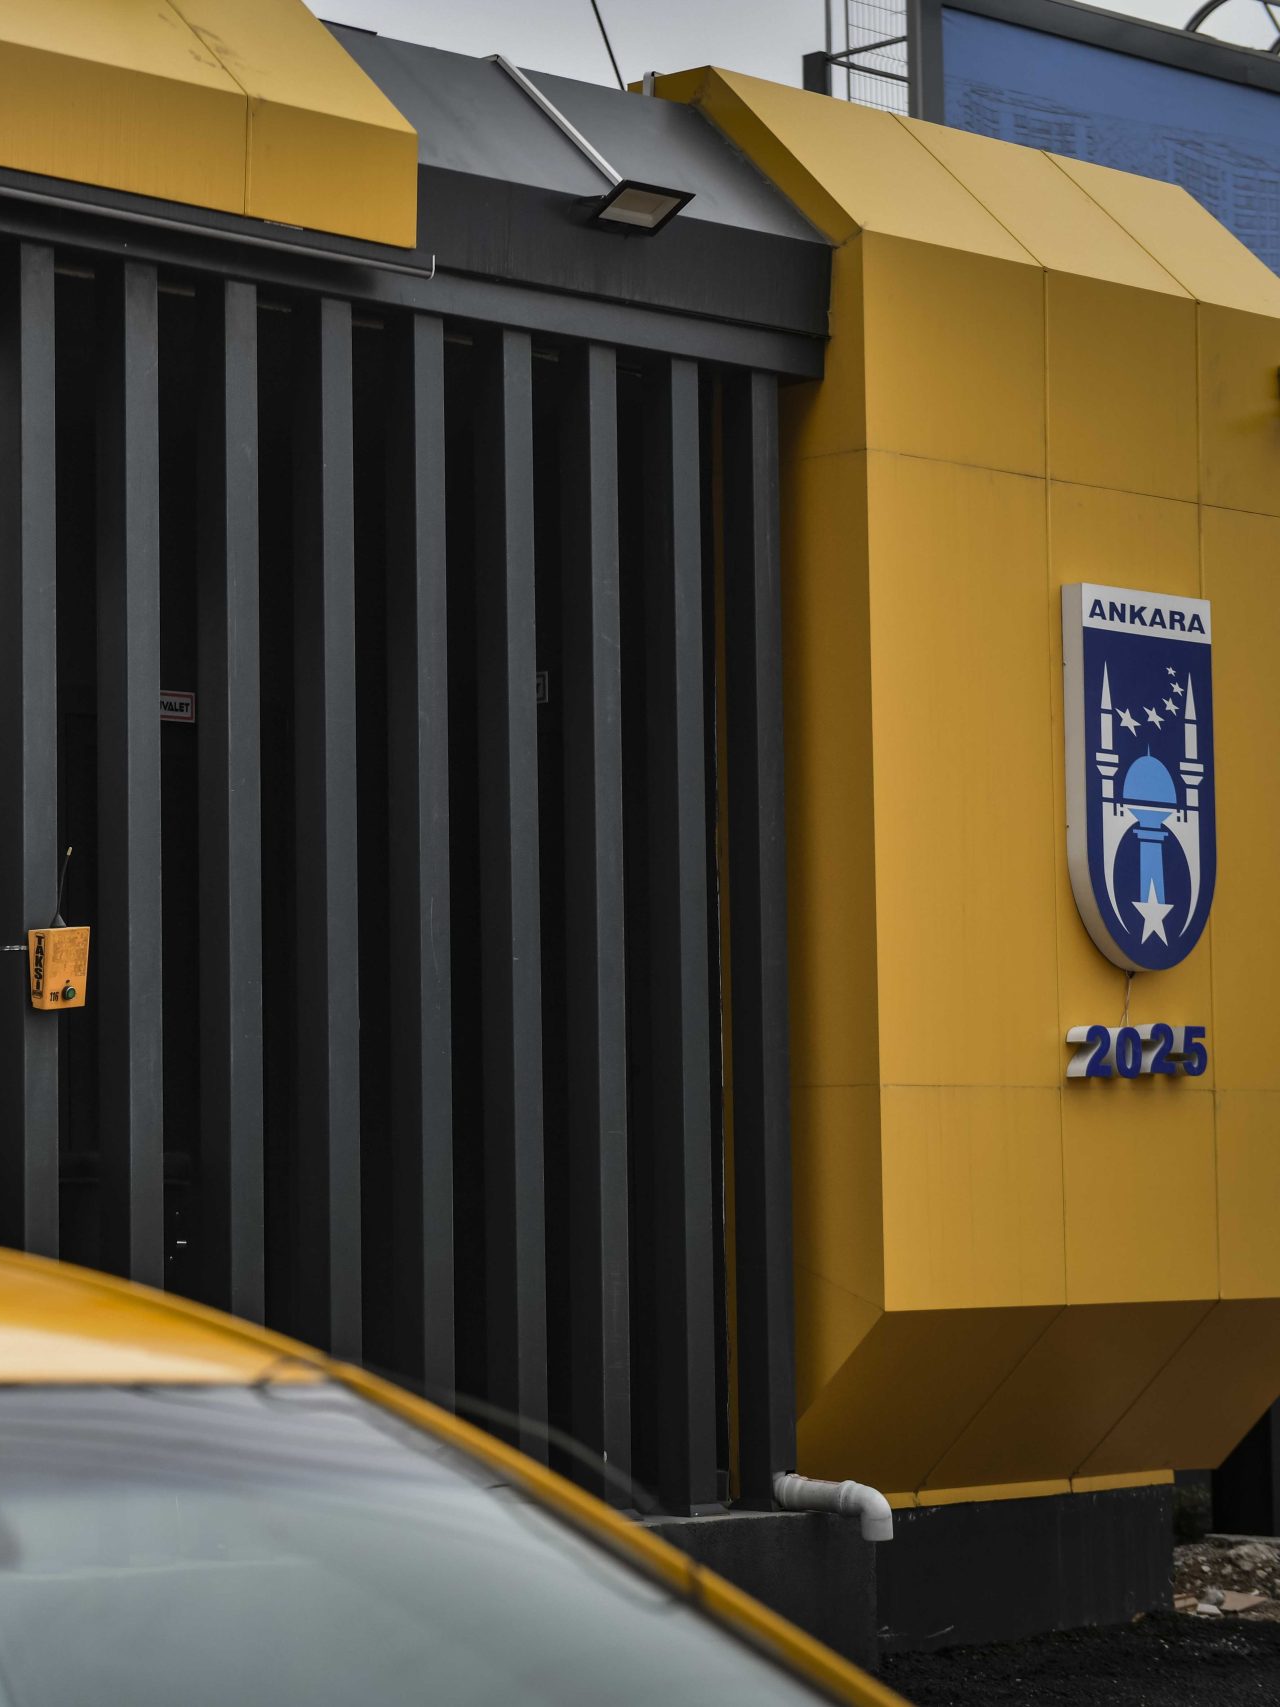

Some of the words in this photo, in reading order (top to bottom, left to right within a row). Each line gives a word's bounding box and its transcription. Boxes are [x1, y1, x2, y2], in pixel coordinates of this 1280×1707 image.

[1088, 598, 1207, 635] ANKARA
[160, 700, 190, 713] VALET
[1066, 1025, 1208, 1079] 2025
